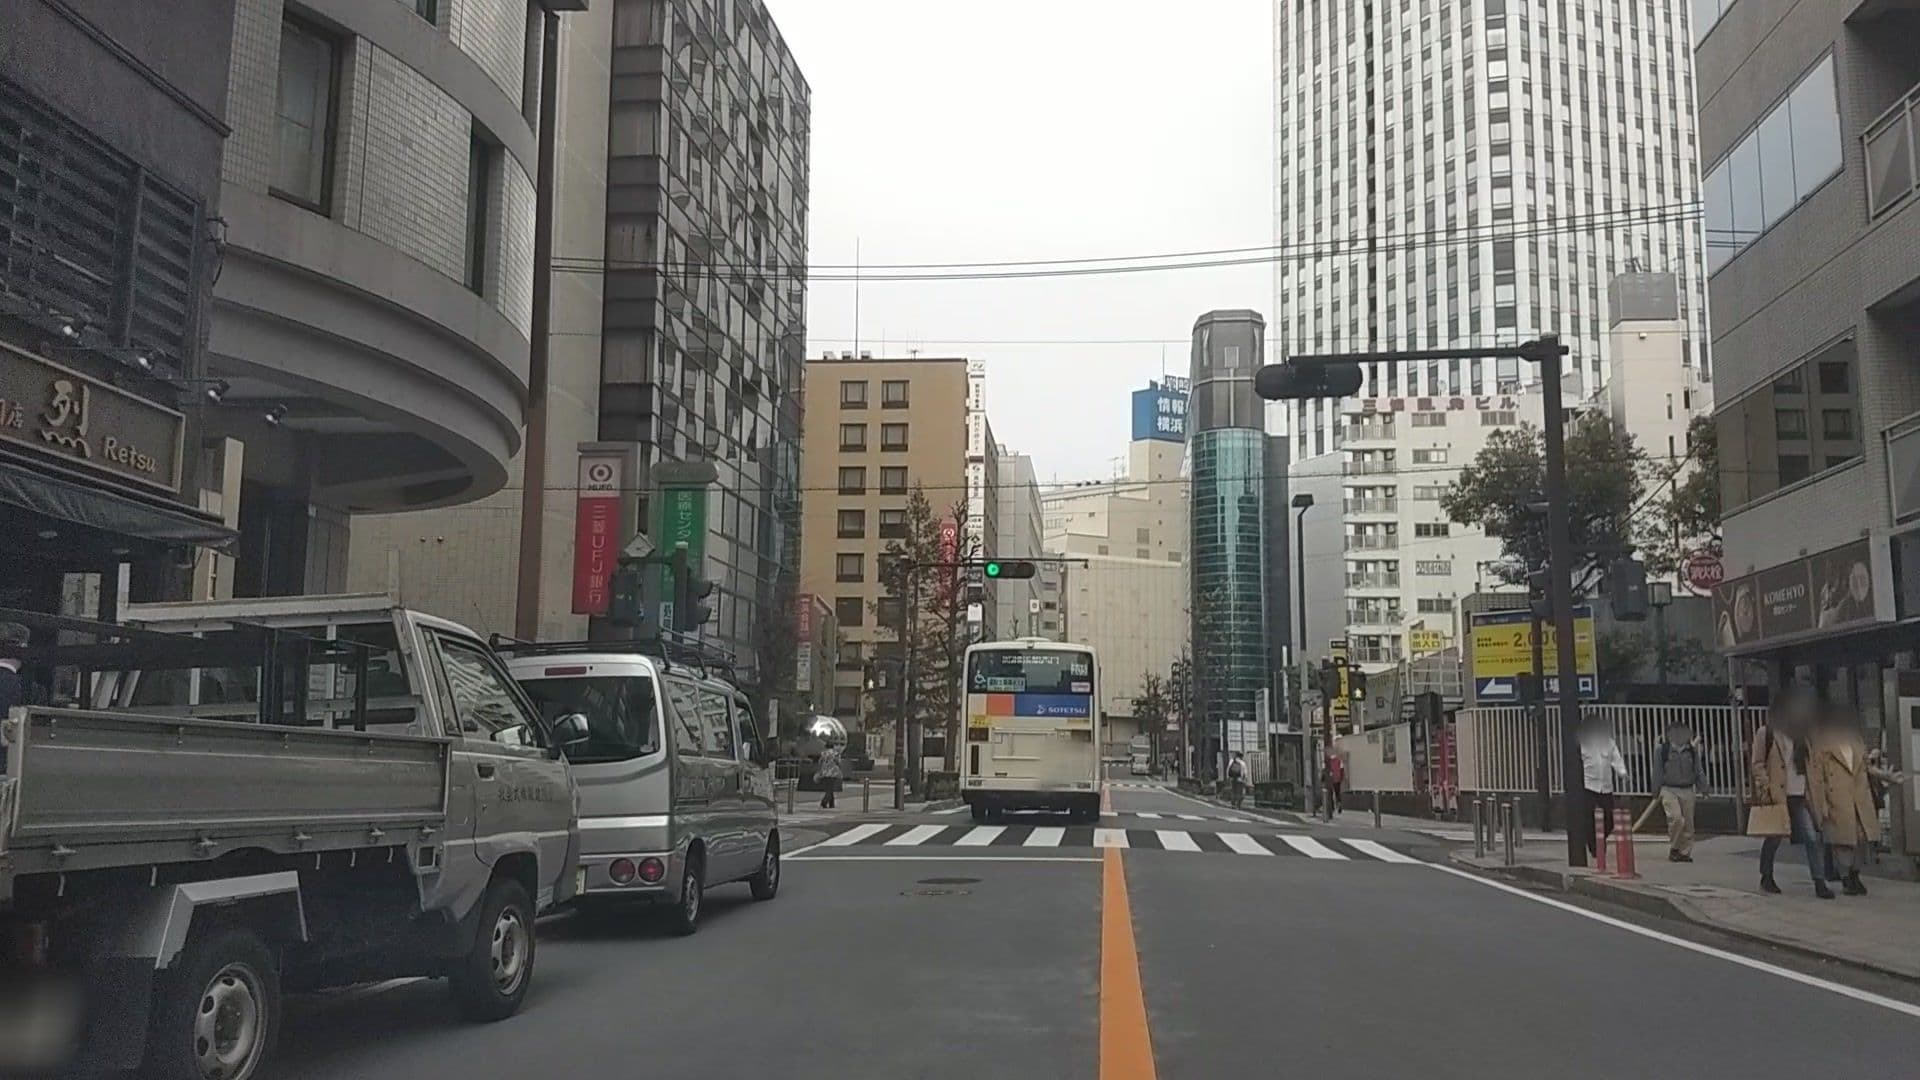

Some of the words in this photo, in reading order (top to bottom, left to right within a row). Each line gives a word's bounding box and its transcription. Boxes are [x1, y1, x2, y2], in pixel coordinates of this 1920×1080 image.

[1157, 397, 1189, 415] 情報
[1157, 415, 1184, 433] 横浜
[104, 436, 156, 473] Retsu
[1763, 584, 1805, 607] KOMEHYO
[1412, 640, 1441, 649] 出入口
[1047, 706, 1087, 714] SOTETSU
